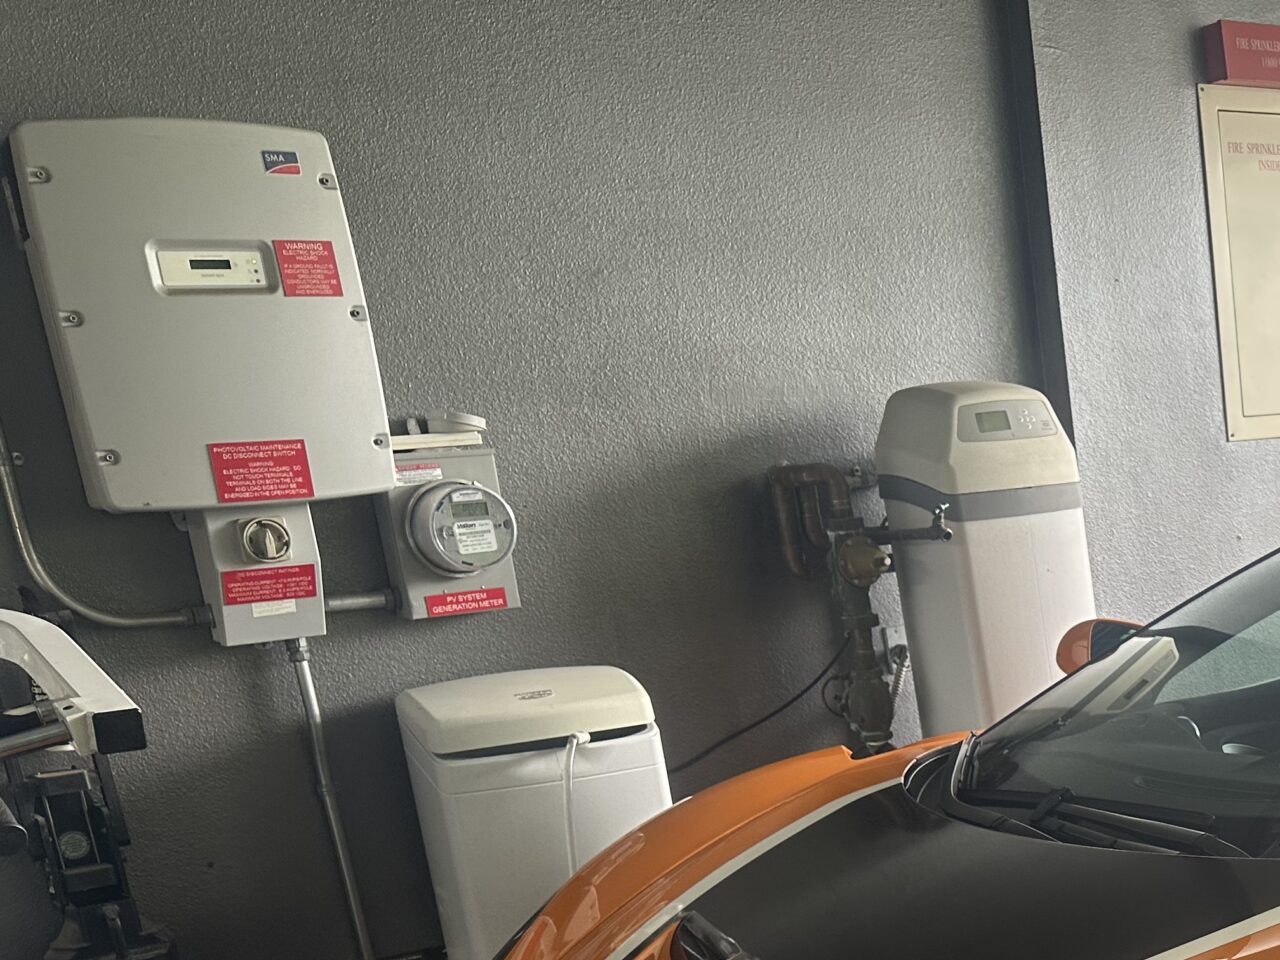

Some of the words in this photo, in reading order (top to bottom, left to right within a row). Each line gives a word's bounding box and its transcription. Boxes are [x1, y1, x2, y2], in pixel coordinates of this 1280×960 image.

[1235, 37, 1249, 50] FIRE
[1250, 38, 1280, 52] SPRINKLER
[1227, 142, 1244, 154] FIRE
[264, 153, 285, 162] SMA
[284, 242, 323, 250] WARNING
[213, 445, 259, 453] PHOTOVOLTAIC
[260, 443, 301, 451] MAINTENANCE
[233, 451, 271, 459] DISCONNECT
[446, 595, 456, 603] PV
[458, 592, 487, 602] SYSTEM
[432, 601, 478, 613] GENERATION
[479, 598, 504, 607] METER
